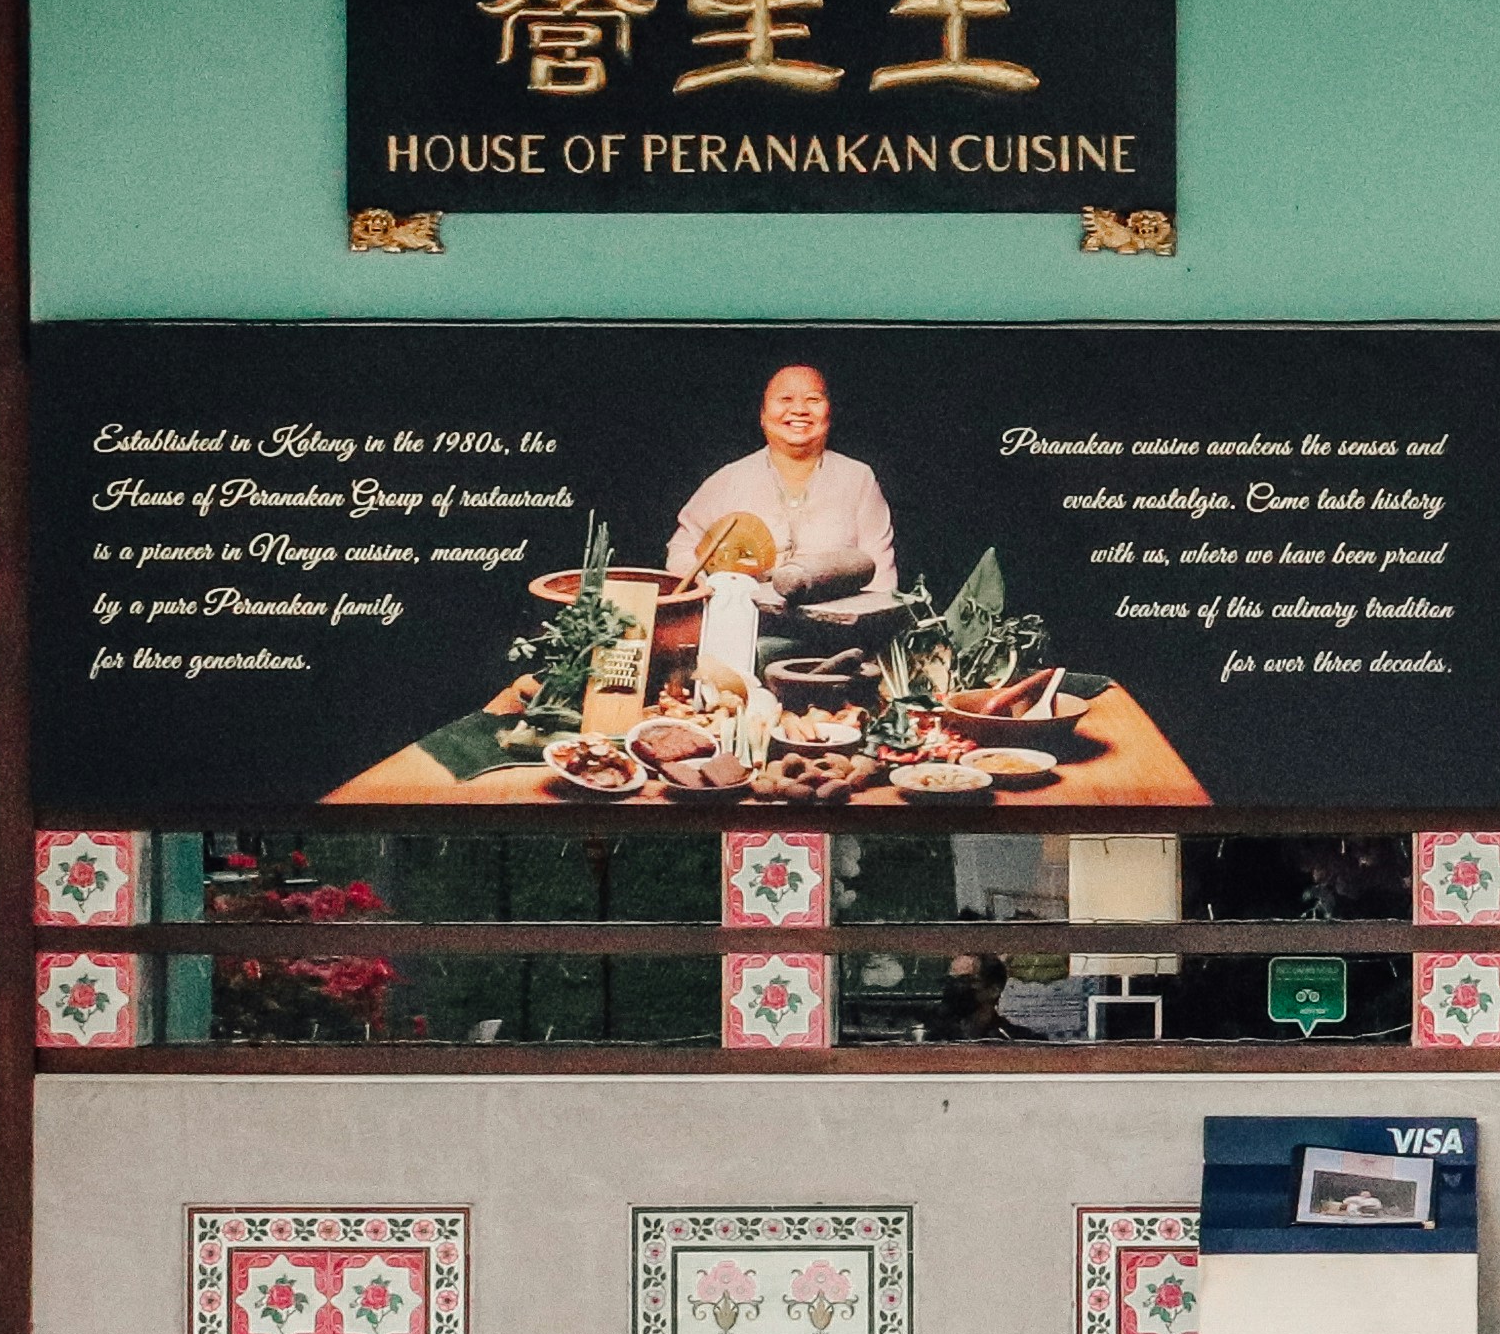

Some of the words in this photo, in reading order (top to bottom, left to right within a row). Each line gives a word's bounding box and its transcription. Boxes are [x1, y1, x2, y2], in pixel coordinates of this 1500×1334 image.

[386, 134, 546, 174] HOUSE
[563, 134, 622, 174] OF
[641, 134, 939, 174] PERANAKAN
[949, 134, 1137, 174] CUISINE
[93, 423, 227, 453] Established
[229, 434, 252, 452] in
[257, 422, 358, 463] Katong
[364, 435, 386, 452] in
[393, 430, 424, 453] the
[432, 431, 510, 456] 1980s,
[519, 431, 557, 453] the
[999, 426, 1125, 456] Peranakan
[1131, 437, 1200, 456] cuisine
[1206, 432, 1294, 456] awakens
[1300, 433, 1332, 456] the
[1337, 440, 1399, 456] senses
[1405, 433, 1449, 456] and
[92, 477, 185, 511] House
[191, 483, 217, 517] of
[219, 478, 346, 508] Peranakan
[349, 477, 424, 519] Group
[431, 484, 457, 518] of
[459, 485, 575, 508] restaurants
[1062, 486, 1127, 510] evokes
[1132, 486, 1236, 520] nostalgia.
[1246, 482, 1310, 513] Come
[1317, 487, 1366, 510] taste
[1370, 487, 1446, 520] history
[93, 543, 112, 560] is
[119, 546, 134, 560] a
[136, 543, 215, 569] pioneer
[221, 543, 243, 561] in
[248, 532, 338, 571] Nonya
[344, 543, 420, 564] cuisine,
[430, 539, 529, 572] managed
[1090, 541, 1135, 564] with
[1142, 548, 1170, 567] us,
[1179, 541, 1239, 564] where
[1245, 549, 1274, 564] we
[1278, 541, 1326, 564] have
[1331, 541, 1377, 565] been
[1379, 542, 1449, 571] proud
[92, 592, 122, 624] by
[129, 600, 144, 615] a
[146, 597, 198, 624] pure
[202, 587, 328, 616] Peranakan
[330, 592, 404, 624] family
[1197, 595, 1222, 629] of
[1226, 595, 1264, 618] this
[1271, 595, 1358, 628] culinary
[1365, 596, 1455, 619] tradition
[89, 646, 124, 680] for
[132, 647, 182, 669] three
[185, 647, 311, 680] generations.
[1220, 649, 1256, 683] for
[1263, 655, 1305, 673] over
[1313, 650, 1362, 673] three
[1369, 650, 1452, 673] decades.
[1387, 1127, 1464, 1154] VISA
